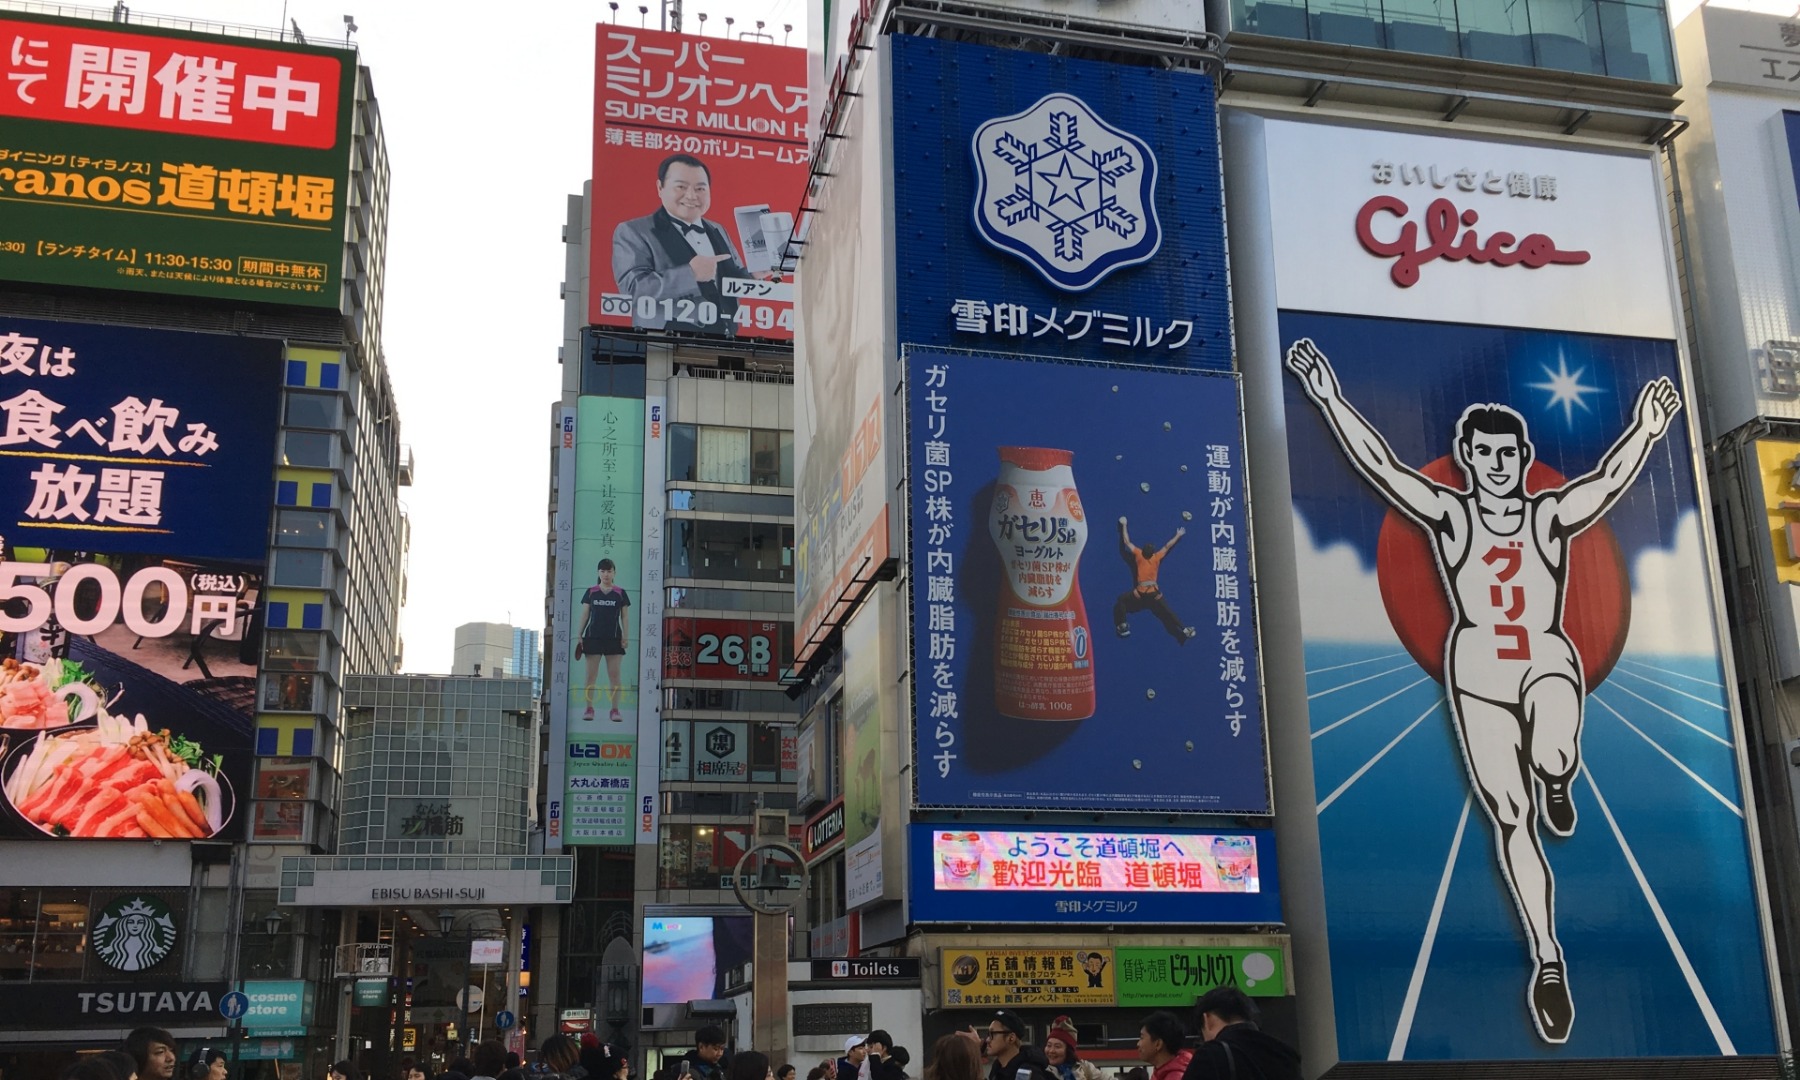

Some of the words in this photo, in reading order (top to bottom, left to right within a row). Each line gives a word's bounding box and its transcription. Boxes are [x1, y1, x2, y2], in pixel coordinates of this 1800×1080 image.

[606, 32, 745, 72] スーパー
[64, 43, 320, 131] 開催中
[605, 100, 689, 125] SUPER
[696, 111, 786, 136] MILLION
[157, 162, 335, 222] 道頓堀
[1371, 159, 1557, 201] おいしさと健康
[1355, 195, 1591, 288] Glico
[144, 252, 232, 271] 11:30-15:30
[242, 259, 322, 280] 期間中無休
[727, 281, 772, 296] ルアン
[637, 296, 794, 332] 0120-494
[951, 299, 1193, 349] 雪印メグミルク
[0, 332, 76, 377] 夜は
[0, 389, 220, 457] 食べ飲み
[25, 462, 165, 525] 放題
[1028, 488, 1047, 508] 恵
[1015, 545, 1064, 560] ヨーグルト
[924, 364, 959, 779] ガセリ菌SP株が内臓脂肪を減らす
[1205, 444, 1247, 737] 運動が内臓脂肪を減らす
[1481, 541, 1531, 660] グリコ
[762, 623, 776, 631] 5F
[697, 634, 771, 666] 268
[1049, 701, 1072, 710] 100g
[416, 802, 452, 815] なんば
[813, 807, 844, 846] LOTTERIA
[1007, 837, 1184, 859] ようこそ道頓堀へ
[992, 860, 1102, 888] 歡迎光臨
[1125, 861, 1202, 888] 道頓堀
[371, 888, 411, 899] EBISU
[1055, 900, 1138, 914] 雪印メグミルク
[851, 963, 900, 976] Toilets
[986, 956, 1073, 971] 店舗情報館
[1170, 953, 1238, 987] ピタットハウス
[78, 991, 213, 1013] TSUTAYA
[247, 1004, 287, 1015] store
[965, 994, 1001, 1003] 株式会社
